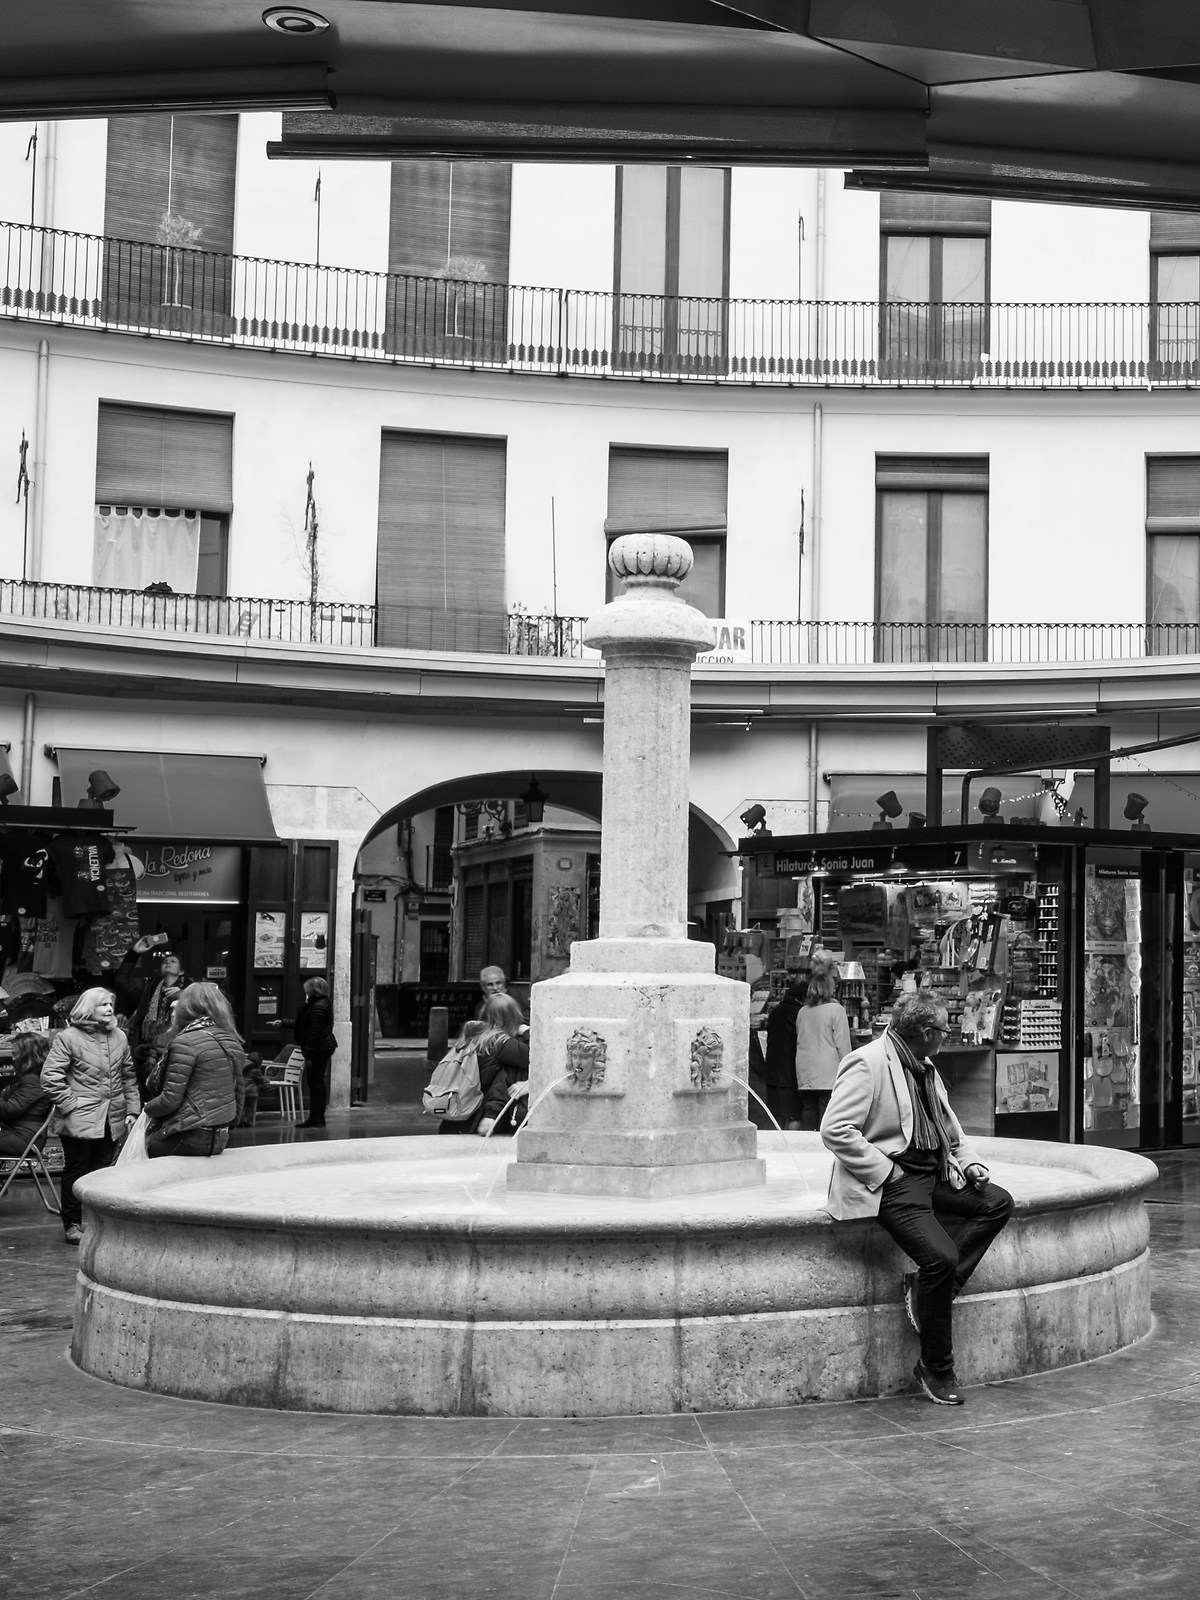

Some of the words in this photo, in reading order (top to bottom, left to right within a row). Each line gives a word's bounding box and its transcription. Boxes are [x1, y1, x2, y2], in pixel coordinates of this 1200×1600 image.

[713, 626, 746, 650] AR
[88, 845, 100, 881] VALENCIA
[160, 845, 212, 872] Redona
[776, 859, 818, 873] Hilaturas
[821, 857, 848, 871] Sonia
[850, 857, 875, 870] Juan
[953, 850, 962, 865] 7
